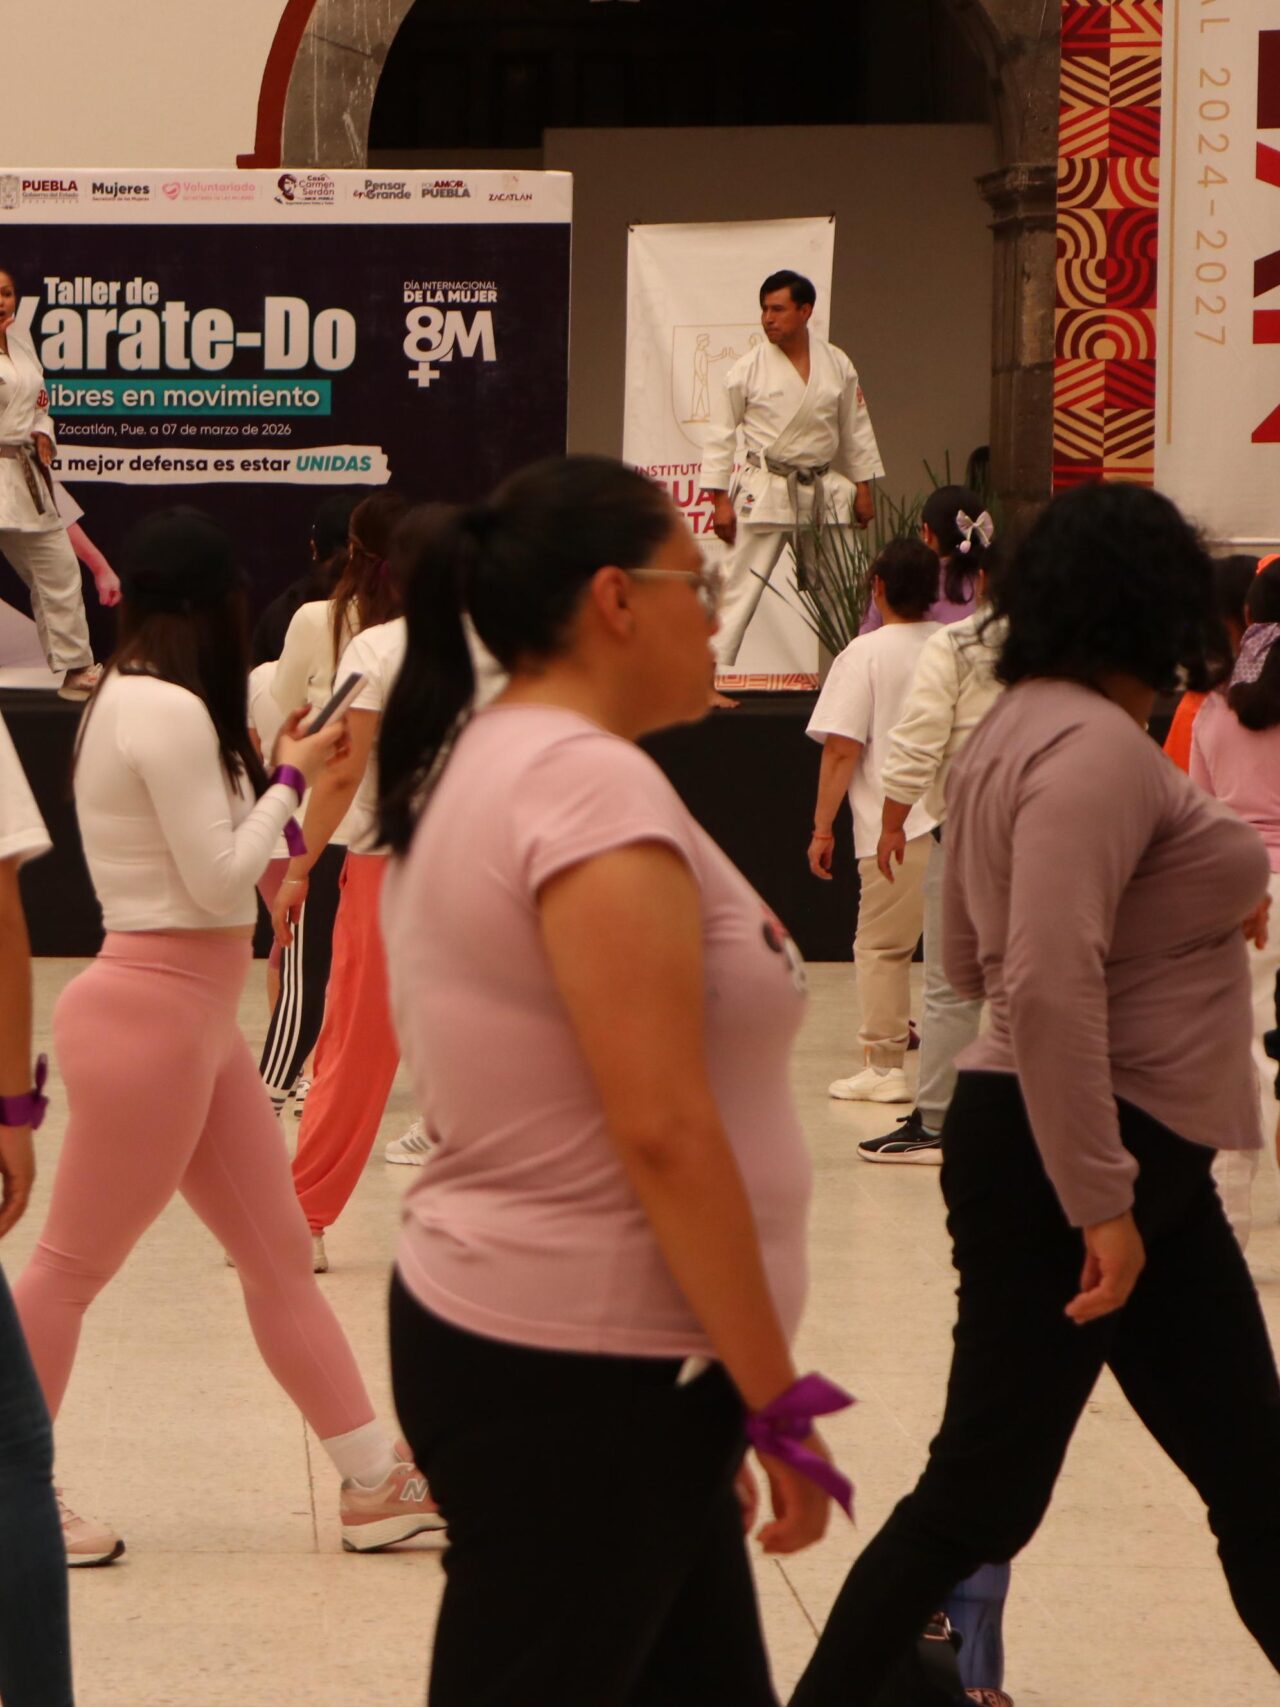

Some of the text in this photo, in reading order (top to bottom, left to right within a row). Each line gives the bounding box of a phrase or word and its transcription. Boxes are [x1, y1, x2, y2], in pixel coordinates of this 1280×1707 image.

[22, 180, 78, 191] PUEBLA
[92, 182, 150, 198] Mujeres
[183, 181, 256, 192] Voluntariado
[298, 180, 335, 189] Carmen
[364, 179, 406, 190] Pensar
[366, 188, 411, 200] Grande
[421, 187, 471, 198] PUEBLA
[1195, 67, 1231, 347] 2024-2027
[43, 276, 160, 306] Taller de
[403, 280, 498, 290] DÍA INTERNACIONAL
[403, 290, 498, 303] DE LA MUJER
[403, 305, 497, 362] 8M
[49, 383, 321, 407] ibres en movimiento
[58, 423, 292, 437] Zacatlán, Pue. a 07 de marzo de 2026
[50, 455, 373, 476] a mejor defensa es estar UNIDAS
